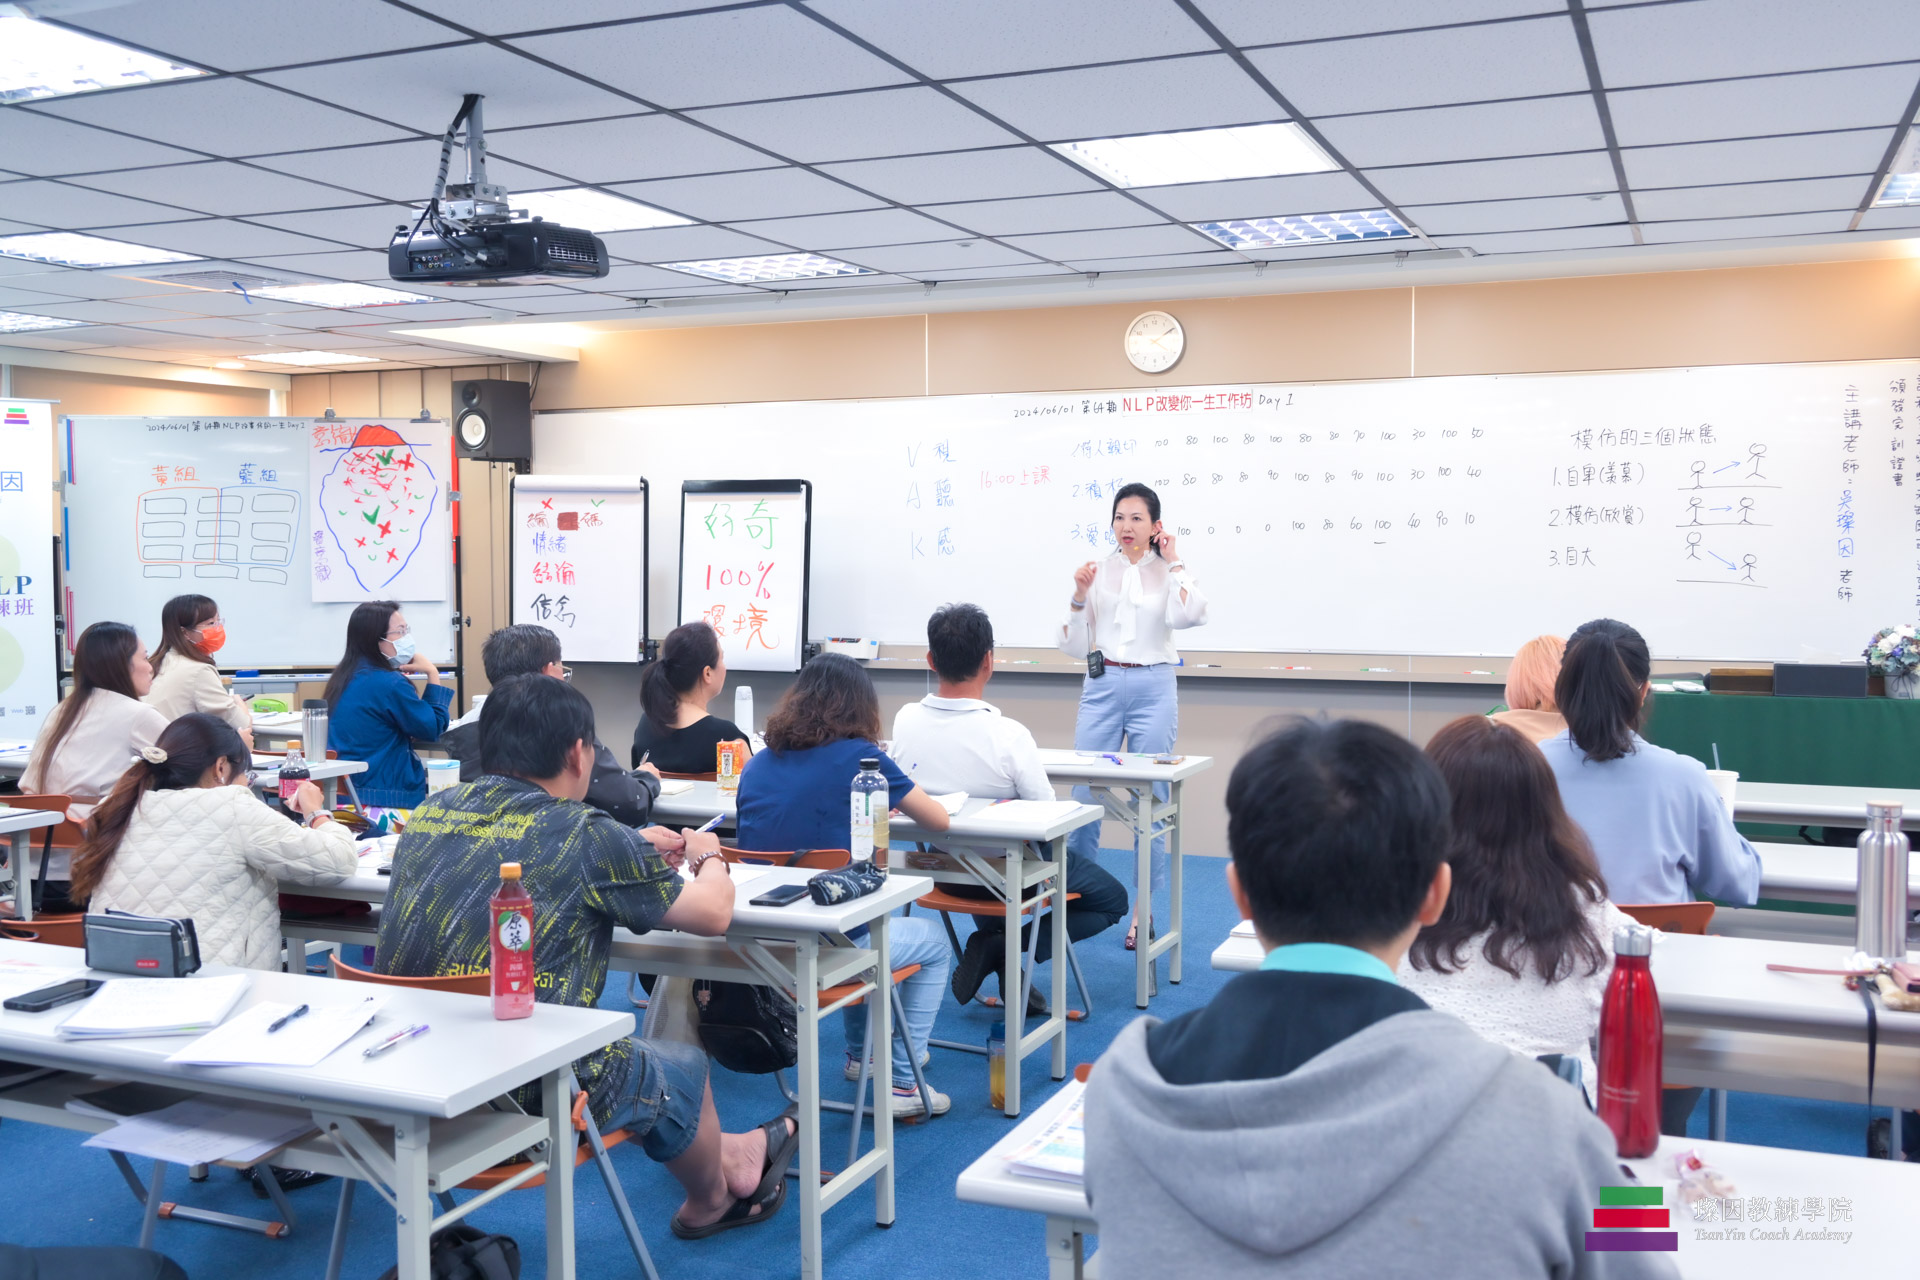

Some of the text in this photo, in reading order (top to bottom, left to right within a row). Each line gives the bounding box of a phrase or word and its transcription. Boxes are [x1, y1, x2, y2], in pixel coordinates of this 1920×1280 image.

[1259, 394, 1280, 410] Day
[0, 471, 23, 492] 因
[706, 561, 774, 599] 100%
